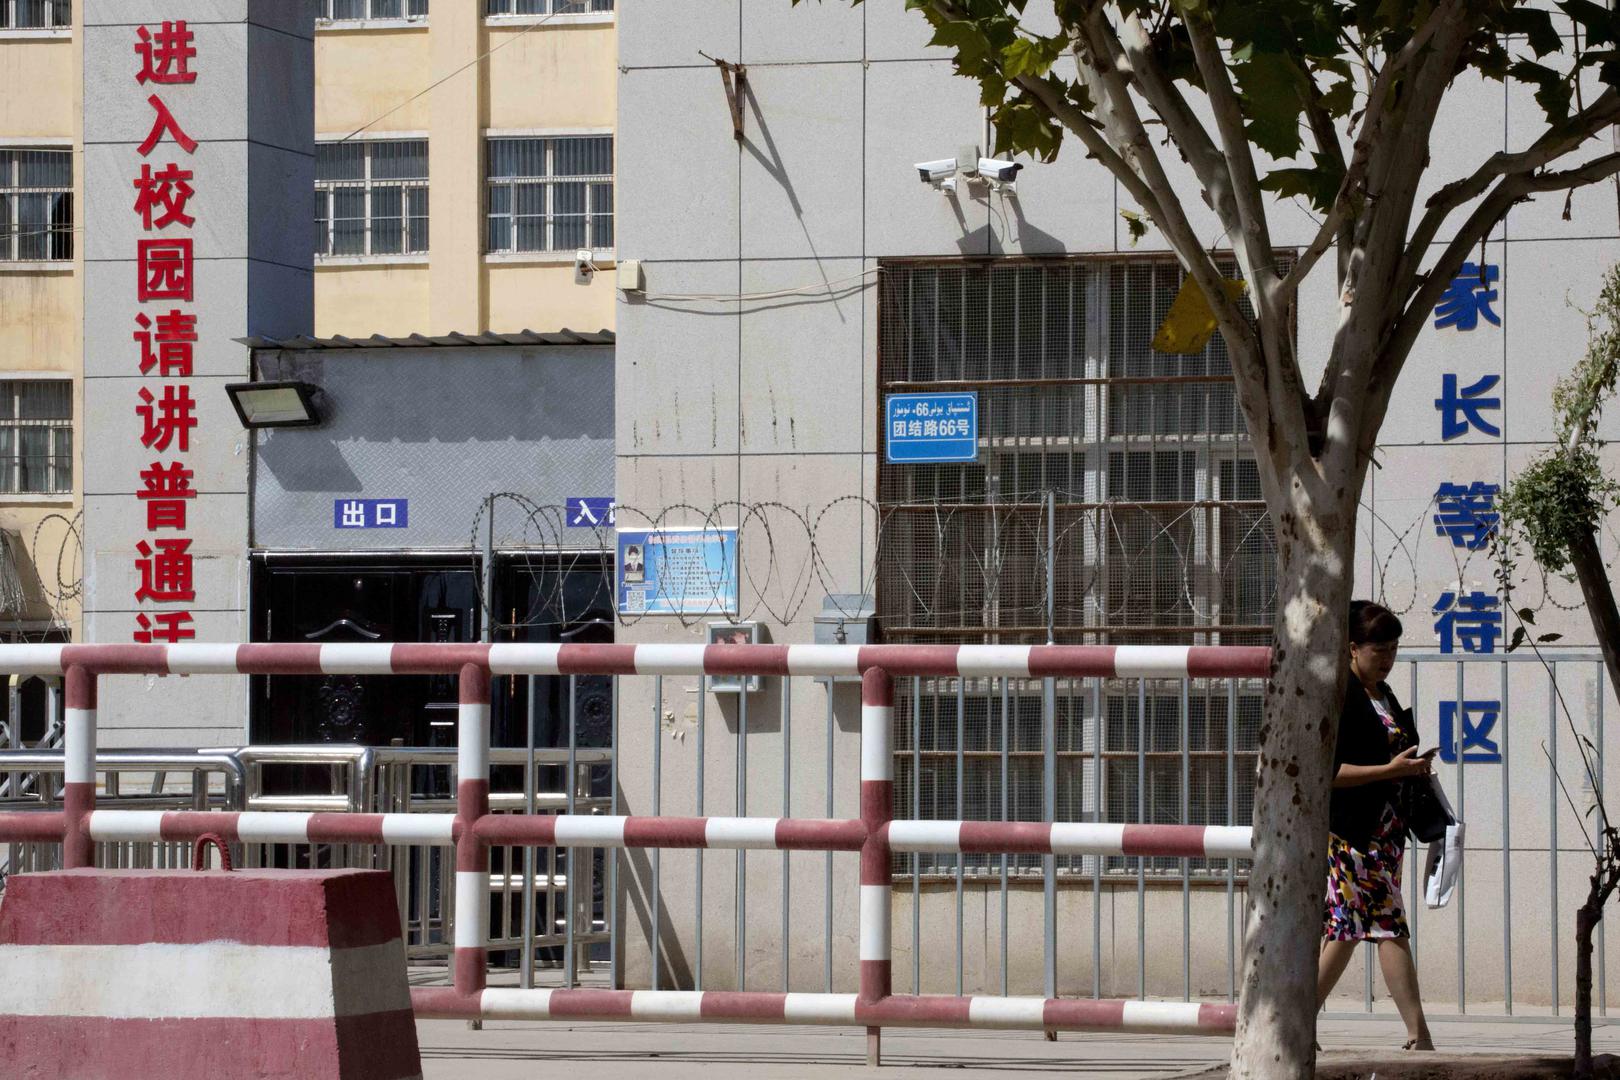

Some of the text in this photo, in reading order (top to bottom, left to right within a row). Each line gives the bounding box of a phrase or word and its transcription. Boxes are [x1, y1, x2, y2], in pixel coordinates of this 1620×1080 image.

[893, 419, 970, 437] 团结路66号
[342, 501, 396, 526] 出口
[1434, 262, 1501, 763] 家长等待区
